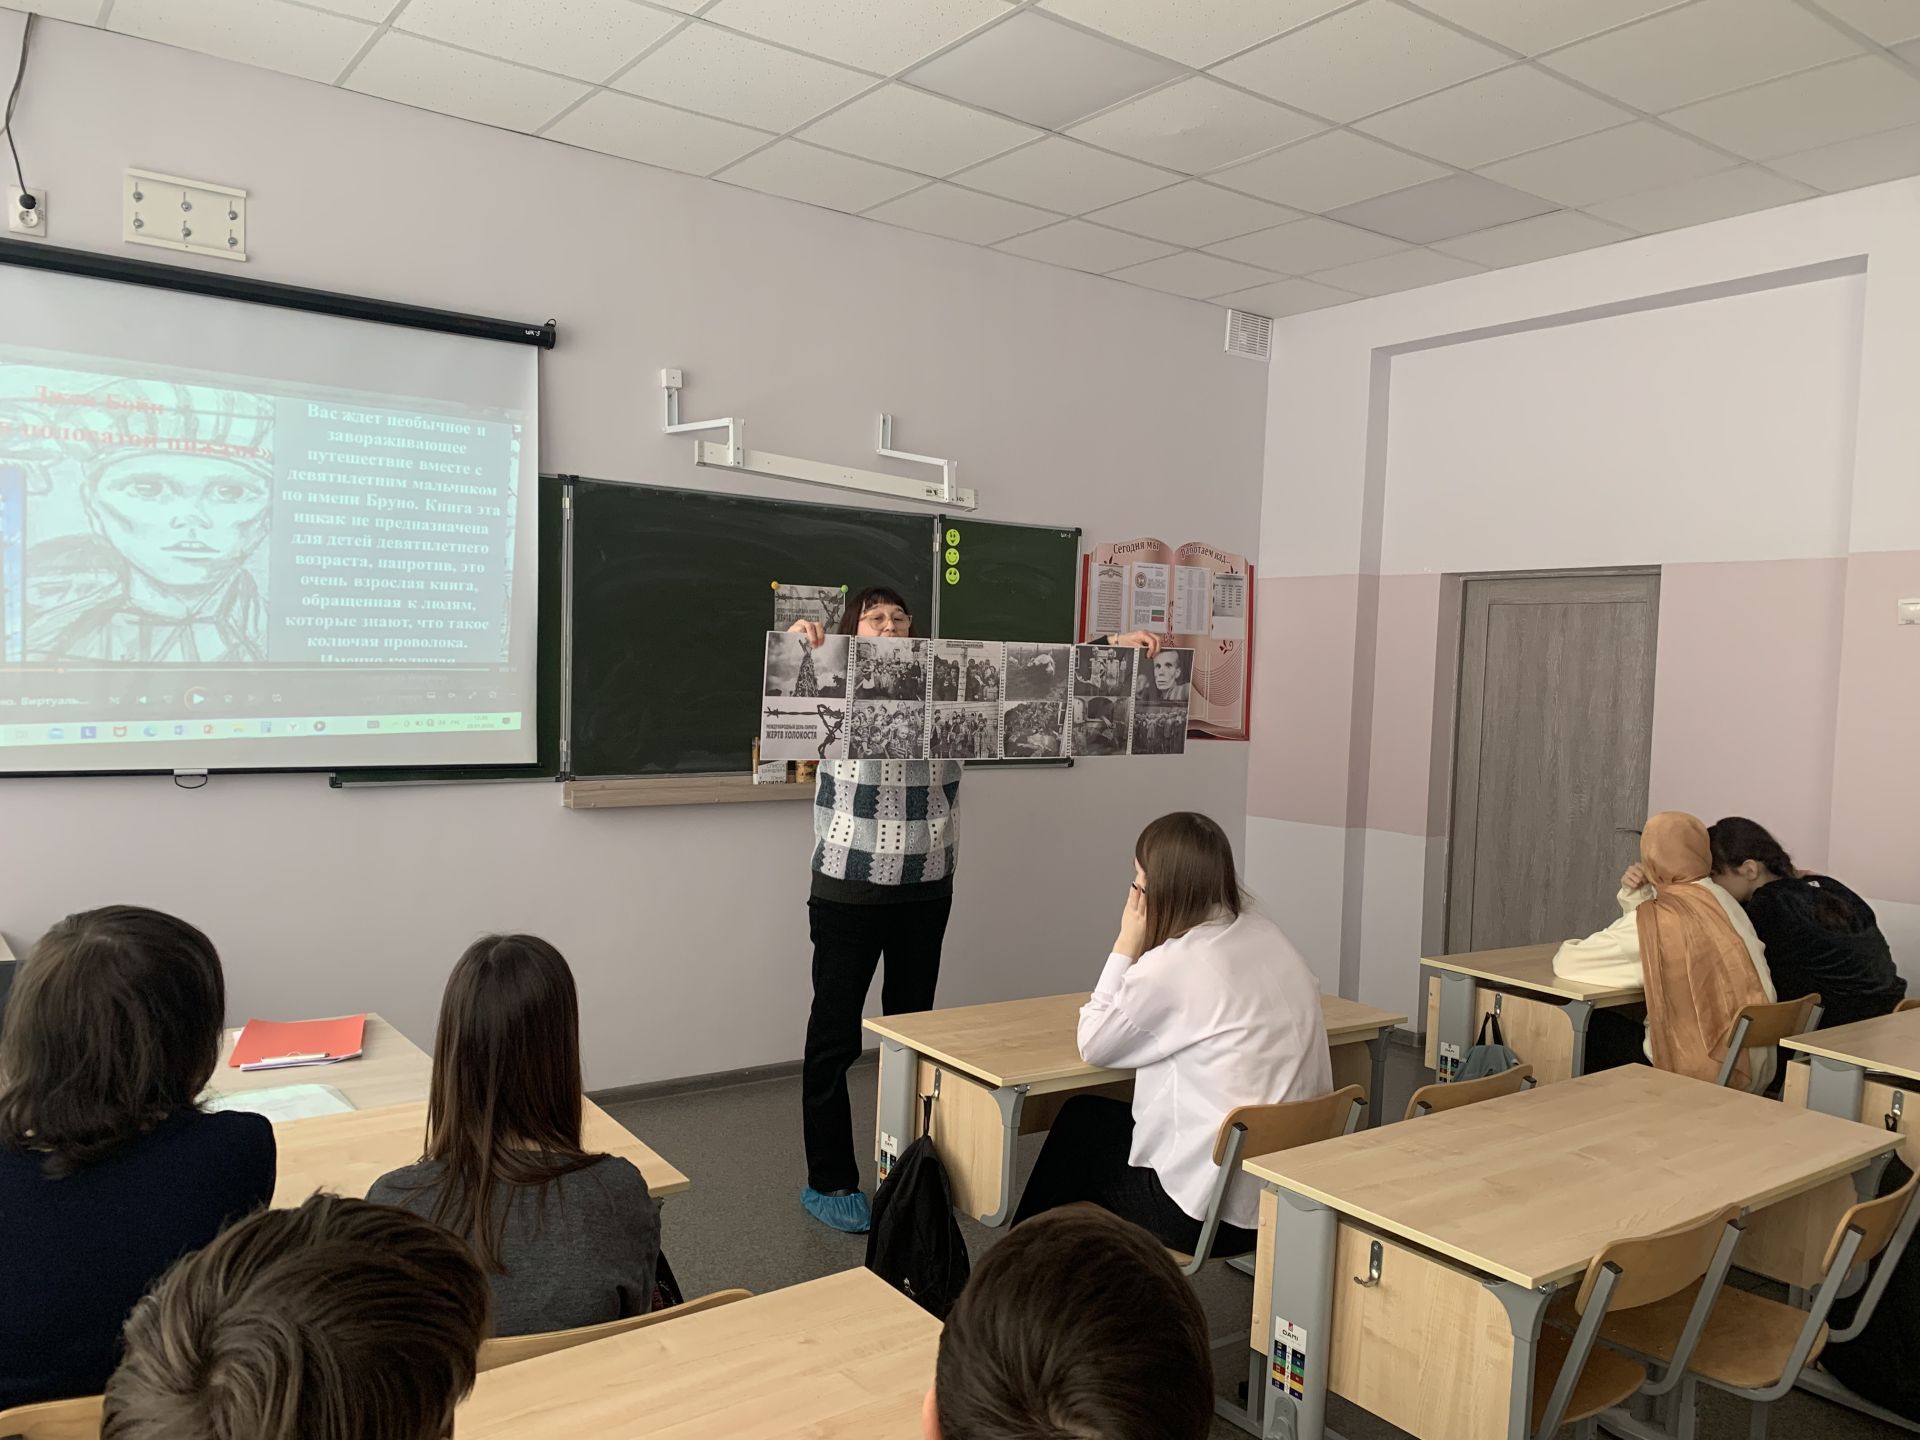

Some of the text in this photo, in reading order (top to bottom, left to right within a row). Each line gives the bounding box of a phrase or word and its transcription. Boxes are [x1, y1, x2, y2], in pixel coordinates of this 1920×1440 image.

[307, 403, 487, 437] Вас ждет необычное и
[327, 428, 468, 455] завораживающее
[307, 448, 484, 477] путешествие вместе с
[287, 467, 498, 498] девятилетним мальчиком
[282, 488, 502, 517] по имени Бруно. Книга эта
[293, 511, 490, 536] никак не предназначена
[291, 532, 490, 556] для детей девятилетнего
[1113, 541, 1145, 555] Сегодня
[1146, 541, 1160, 551] мы
[1180, 544, 1214, 560] работаем
[295, 553, 486, 574] возраста, напротив, это
[300, 573, 479, 593] очень взрослая книга,
[301, 593, 477, 612] обращенная к людям,
[285, 614, 490, 631] которые знают, что такое
[307, 635, 469, 651] колючая проволока.
[766, 731, 818, 740] ЖЕРТВ ХОЛОКОСТА
